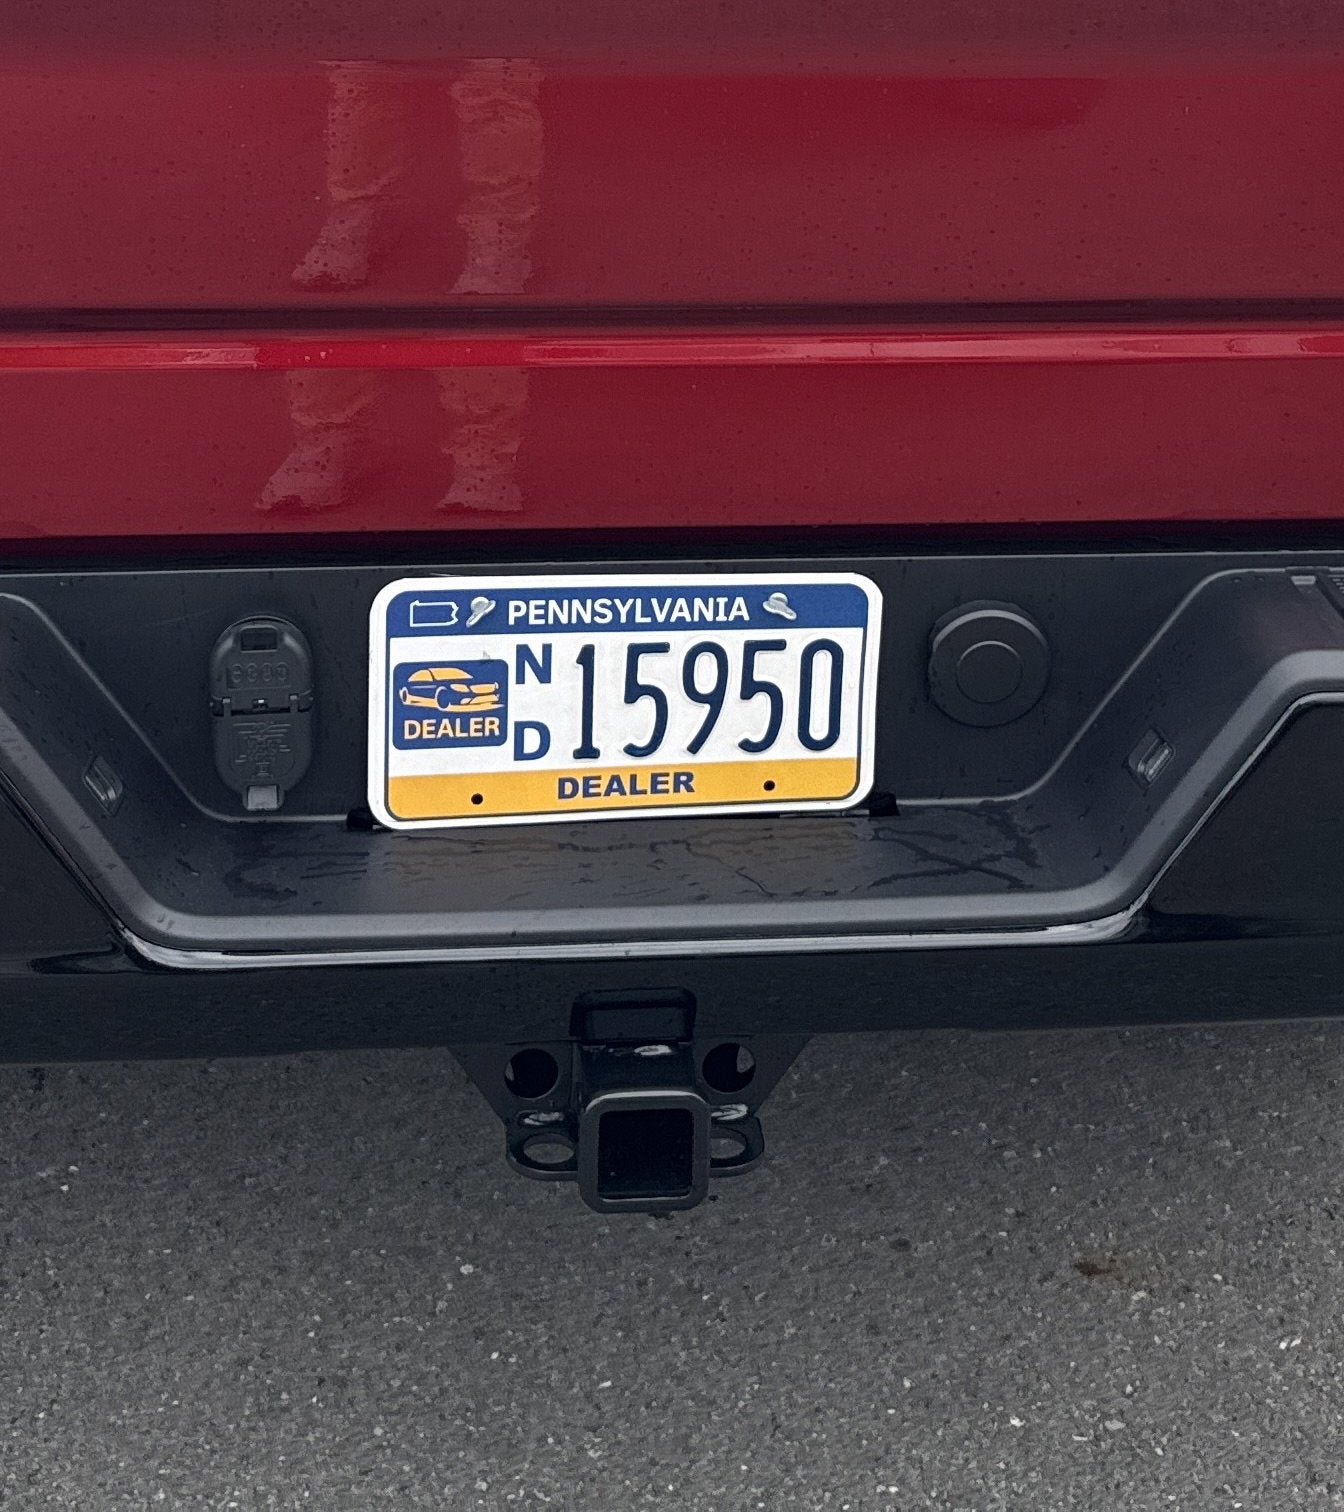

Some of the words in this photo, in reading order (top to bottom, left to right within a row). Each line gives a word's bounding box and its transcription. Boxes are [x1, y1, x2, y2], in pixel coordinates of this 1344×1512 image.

[508, 596, 751, 626] PENNSYLVANIA
[571, 638, 845, 760] 15950
[403, 717, 501, 740] DEALER
[557, 771, 696, 800] DEALER
